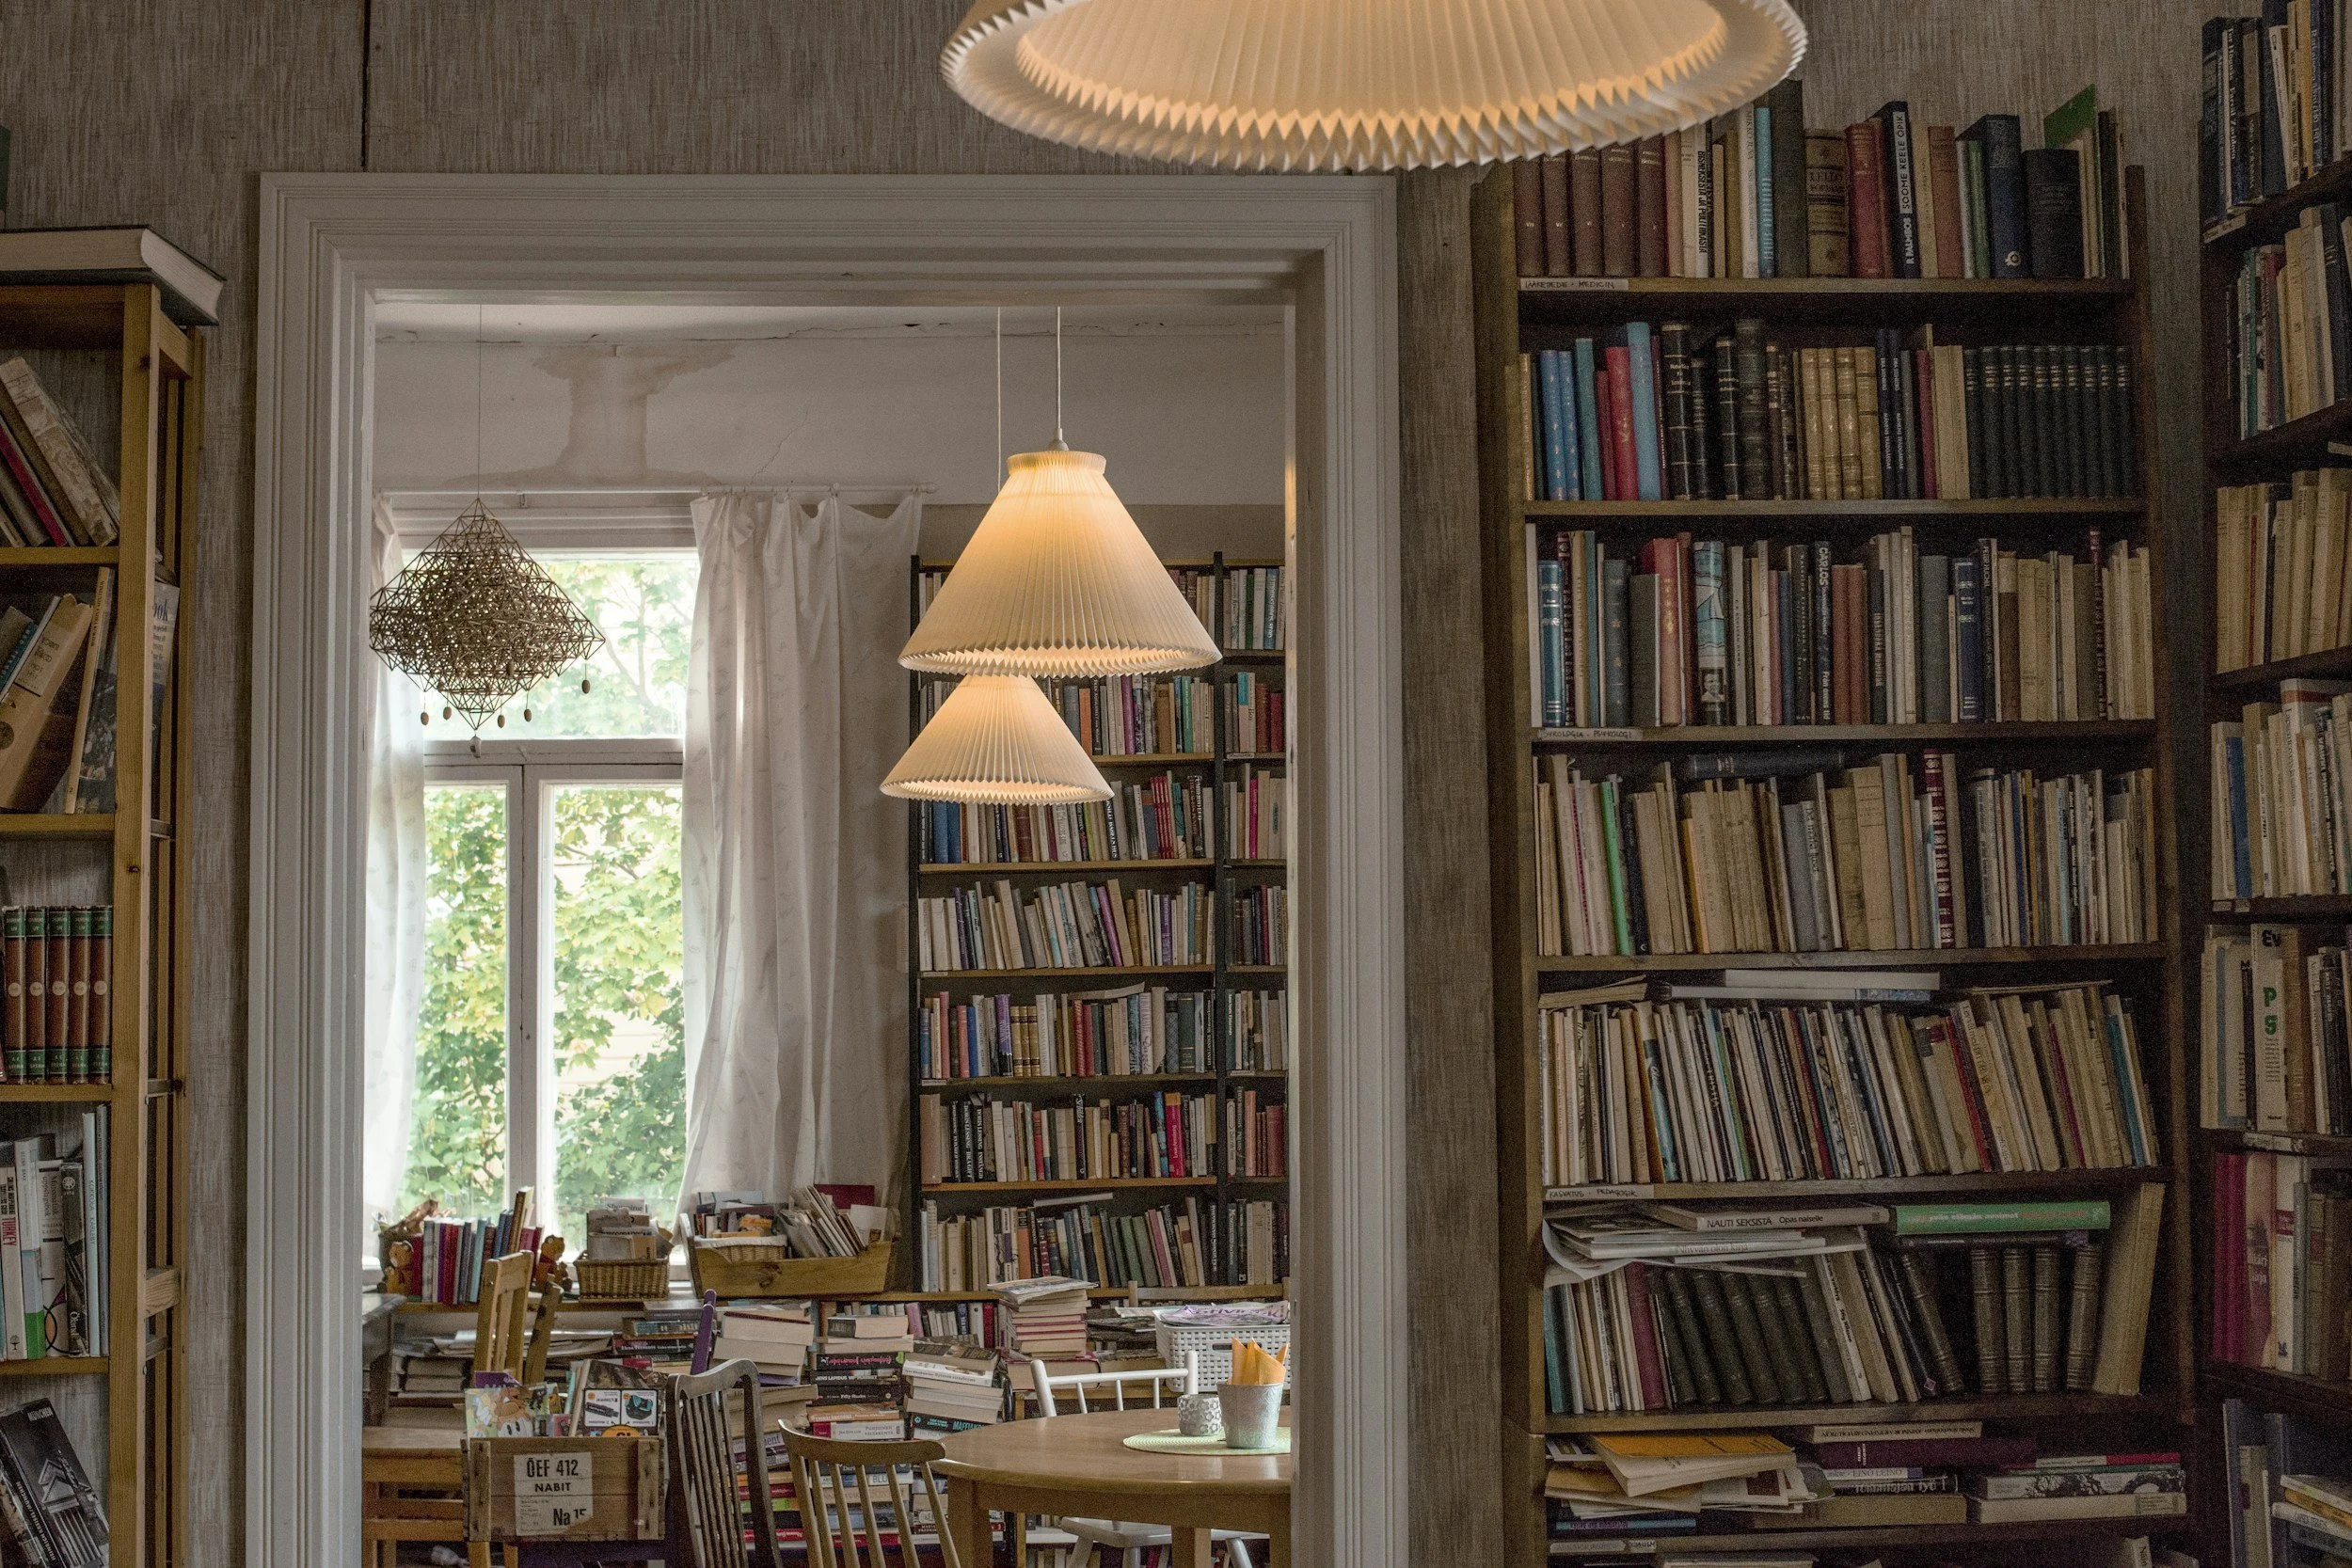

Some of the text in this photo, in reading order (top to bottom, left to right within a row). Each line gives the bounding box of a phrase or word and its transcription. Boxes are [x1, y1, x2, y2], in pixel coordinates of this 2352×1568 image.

[1897, 139, 1908, 170] KEELE
[1899, 171, 1911, 210] SOOME
[1578, 280, 1615, 289] MEDICIN
[1819, 546, 1830, 586] CARLOS
[1549, 1190, 1584, 1198] KASVATUS
[2, 1215, 17, 1246] TURKEY
[1707, 1214, 1824, 1228] NAUTI SEKSISTÄ Opas naiselle
[70, 1310, 80, 1336] Öland
[526, 1457, 580, 1478] ÖEF 412
[534, 1482, 572, 1493] NABIT
[552, 1508, 571, 1527] Na
